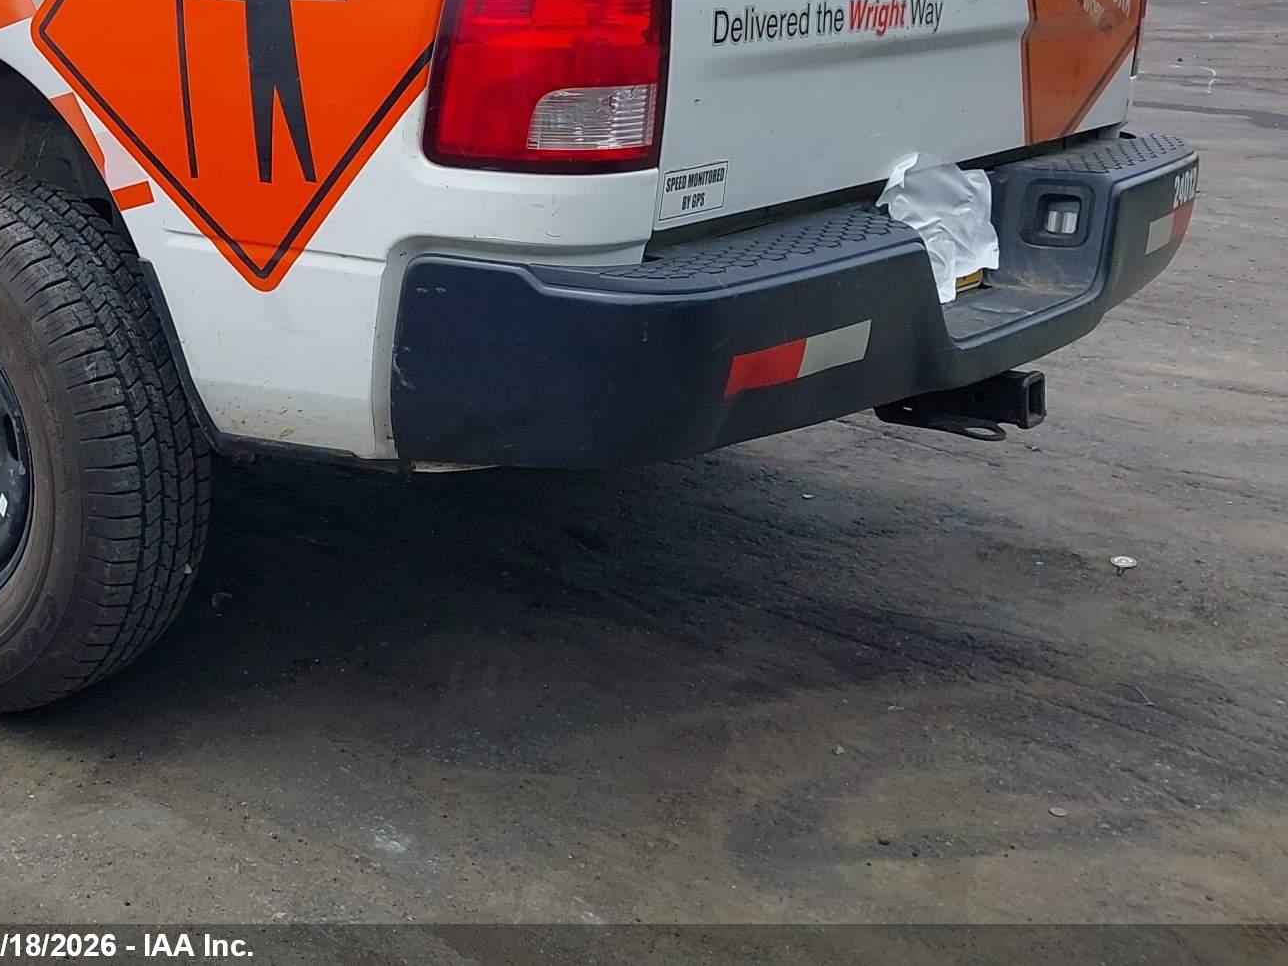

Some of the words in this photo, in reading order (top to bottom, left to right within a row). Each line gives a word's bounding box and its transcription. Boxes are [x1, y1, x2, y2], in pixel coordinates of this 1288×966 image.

[712, 2, 811, 44] Delivered
[816, 1, 844, 33] the
[666, 175, 687, 193] SPEED
[687, 167, 725, 188] MONITORED
[681, 194, 691, 210] BY
[692, 192, 705, 209] GPS
